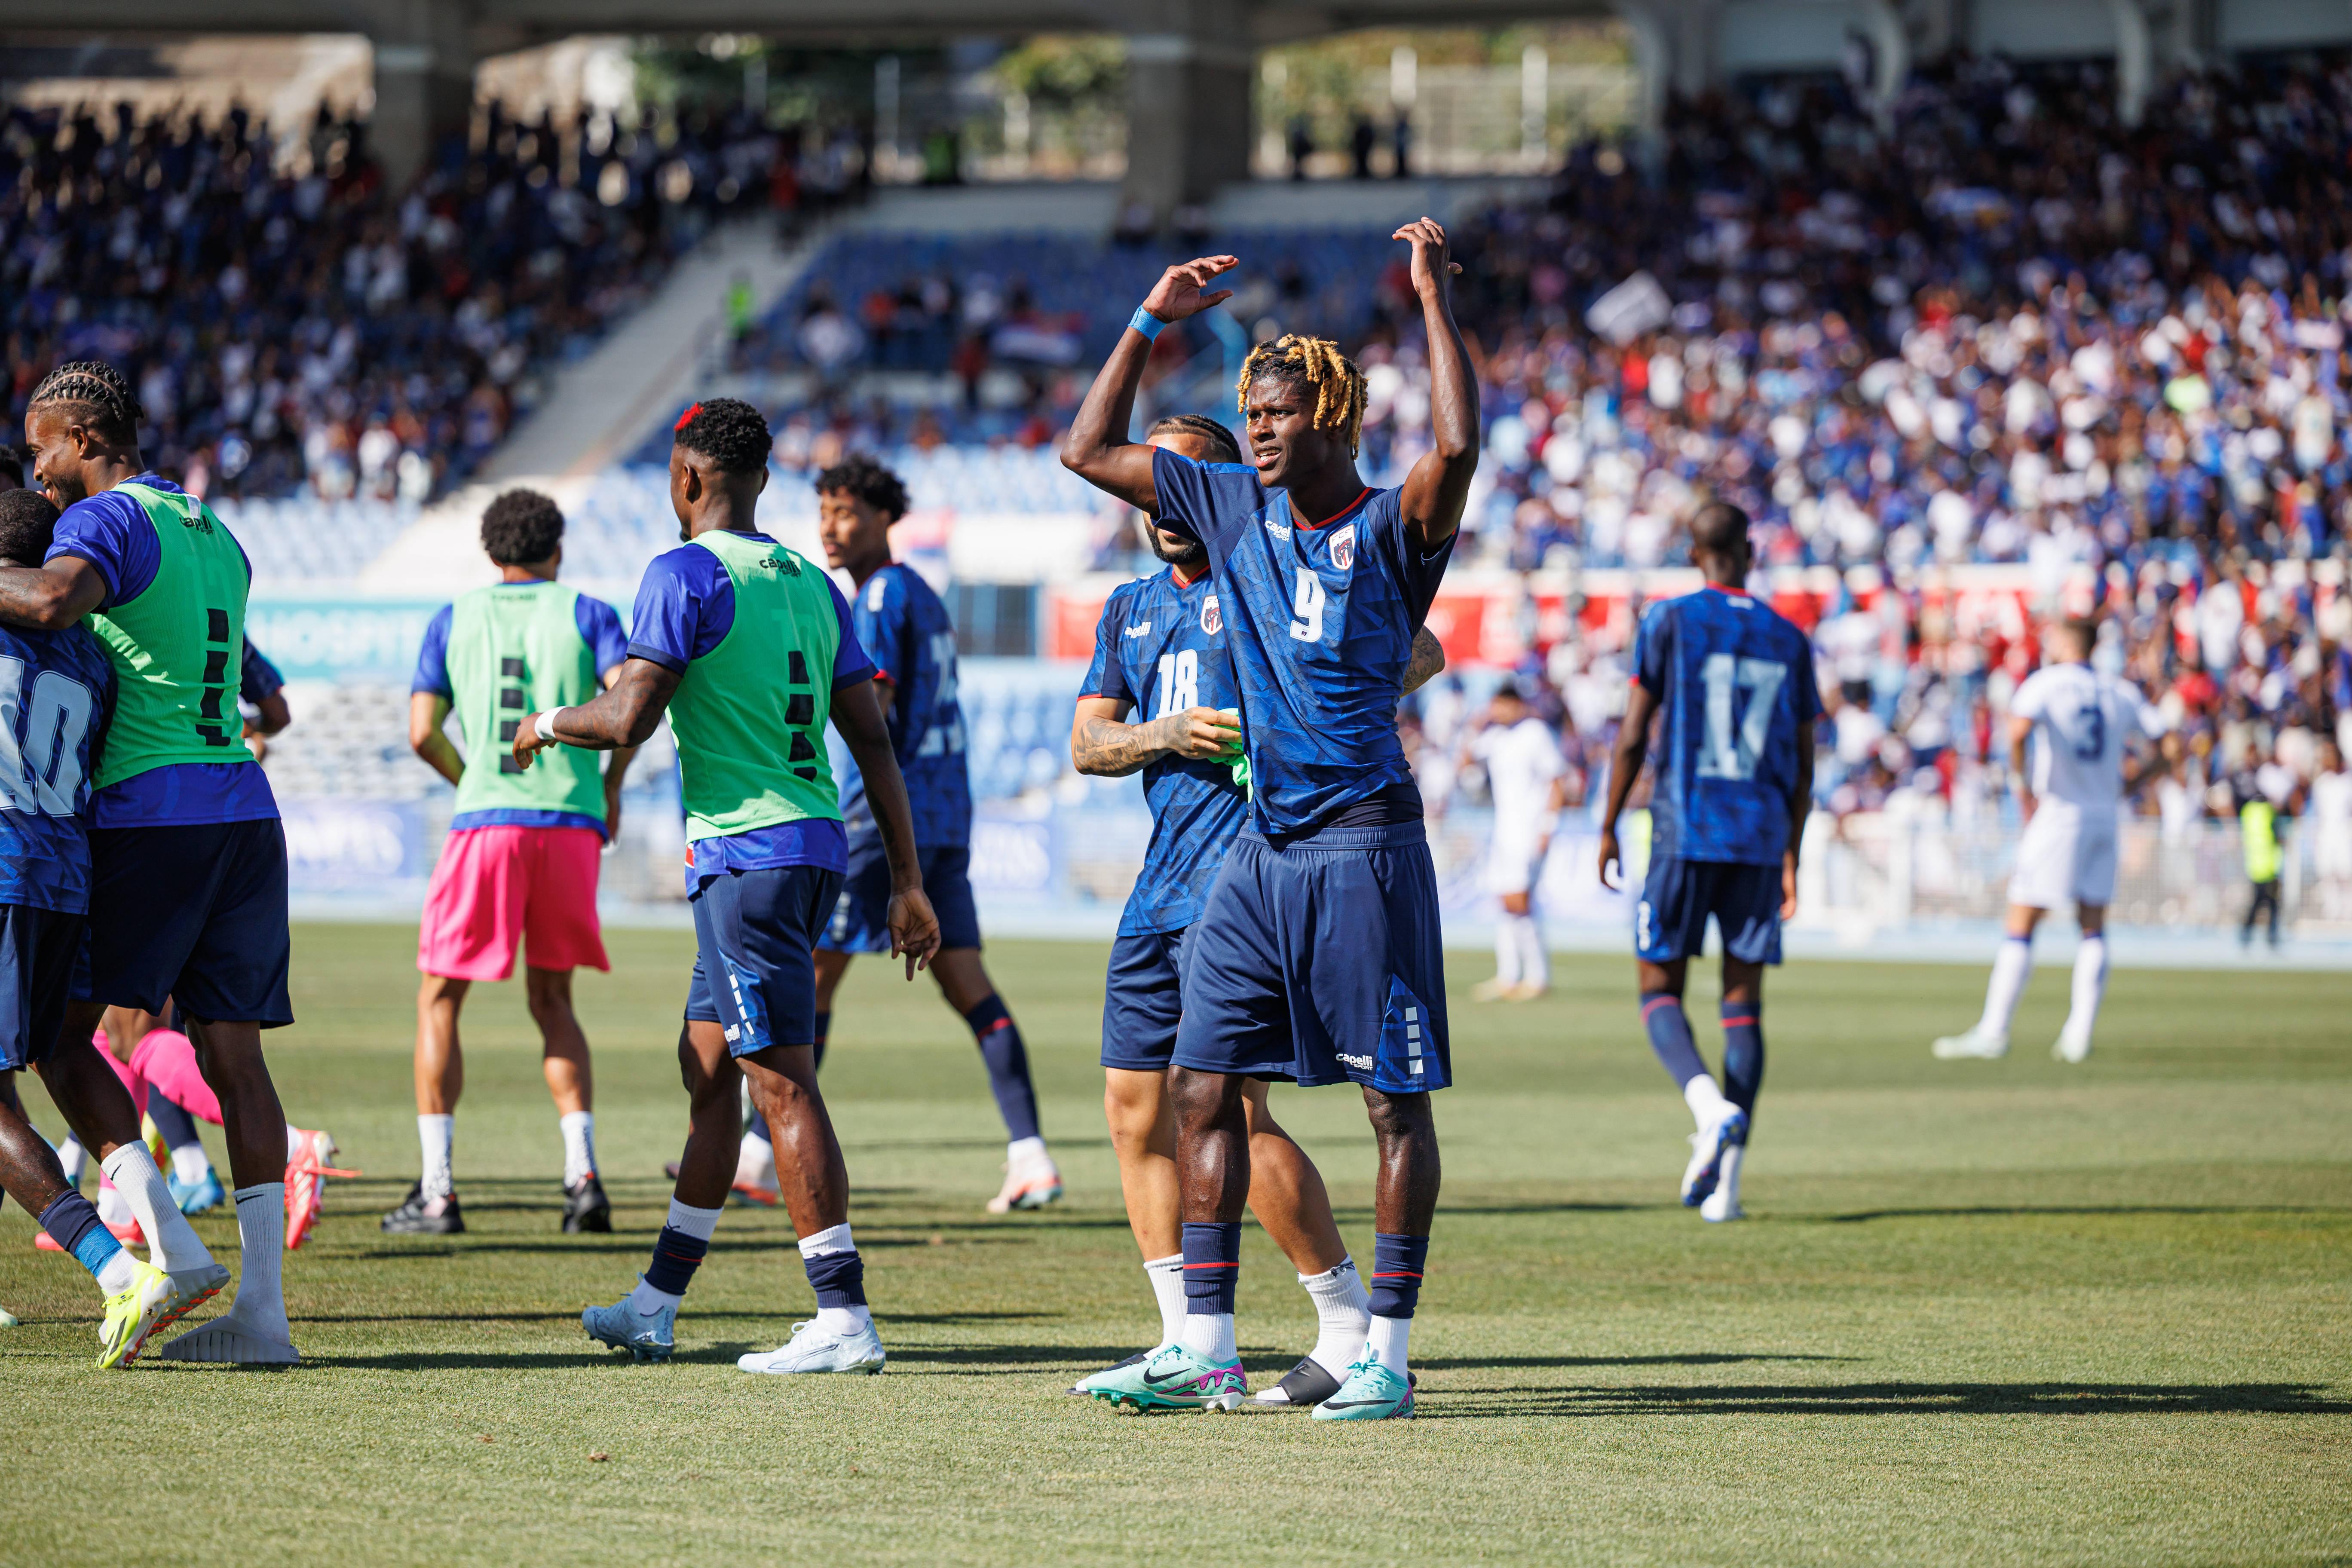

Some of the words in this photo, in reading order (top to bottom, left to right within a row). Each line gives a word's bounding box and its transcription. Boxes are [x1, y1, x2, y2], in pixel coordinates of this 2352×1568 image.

[1290, 566, 1326, 643] 9
[1156, 649, 1198, 720] 18
[1697, 652, 1788, 781] 17
[0, 654, 92, 817] 10
[2075, 705, 2104, 762] 3
[1336, 1053, 1373, 1067] capelli
